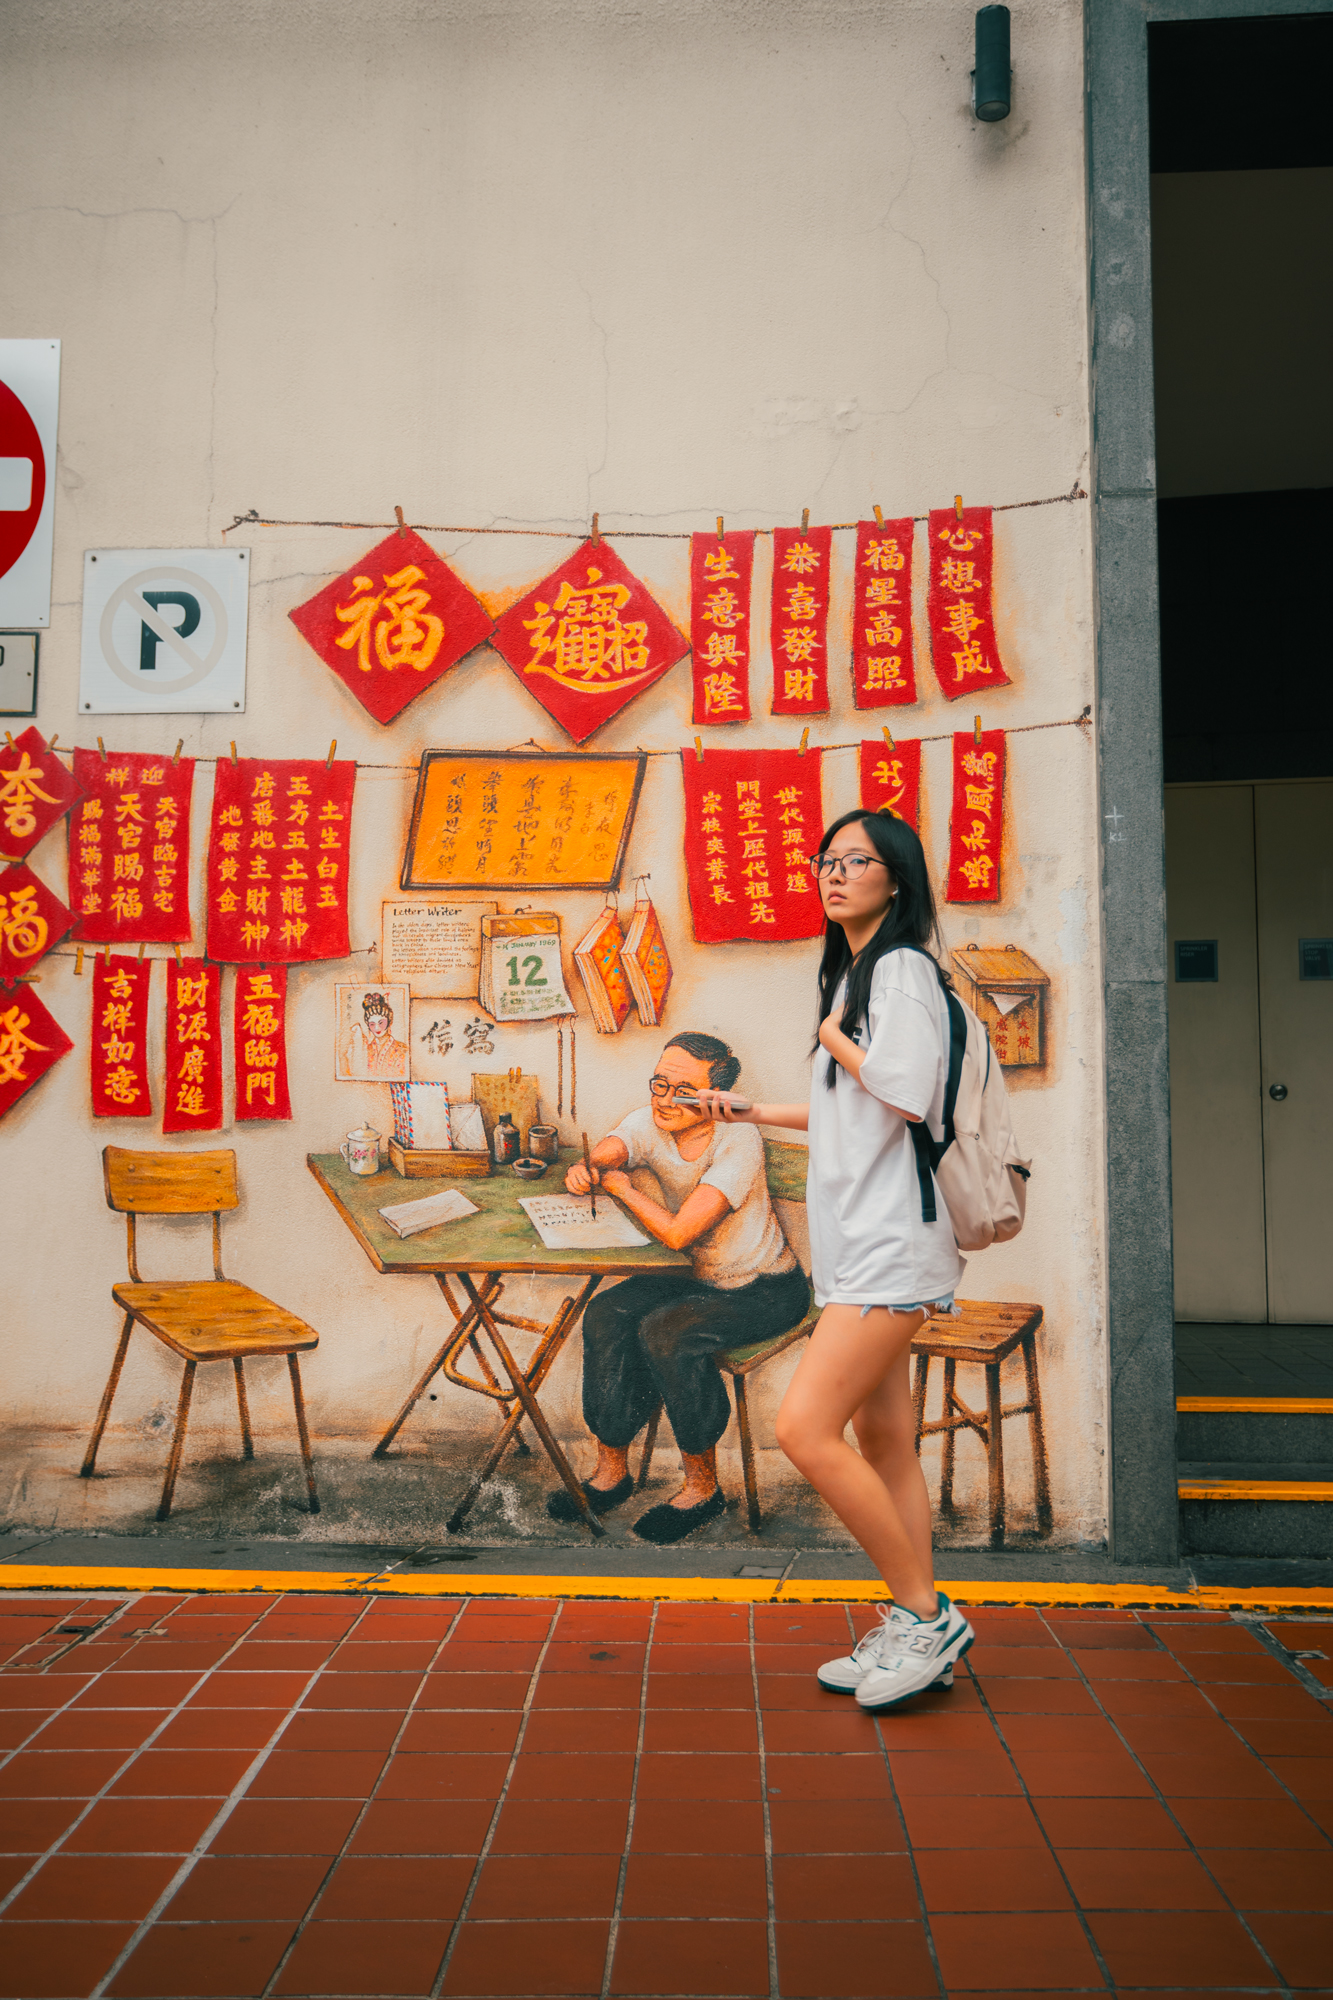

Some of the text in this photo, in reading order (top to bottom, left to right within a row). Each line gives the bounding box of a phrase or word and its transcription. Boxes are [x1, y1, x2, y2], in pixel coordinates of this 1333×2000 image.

[335, 564, 445, 672] 福
[702, 547, 746, 714] 生意興隆
[780, 543, 823, 700] 恭喜發財
[863, 539, 906, 690] 福星高照
[938, 528, 993, 681] 心想事成
[110, 793, 150, 922] 天官賜福
[240, 772, 278, 950] 唐番地主財神
[280, 776, 317, 947] 五方五土龍神
[317, 801, 344, 908] 土生白玉
[393, 906, 462, 917] Letter Writer
[102, 968, 141, 1104] 吉祥如意
[242, 974, 281, 1105] 五福臨門
[506, 954, 548, 987] 12
[176, 972, 211, 1116] 財源廣進
